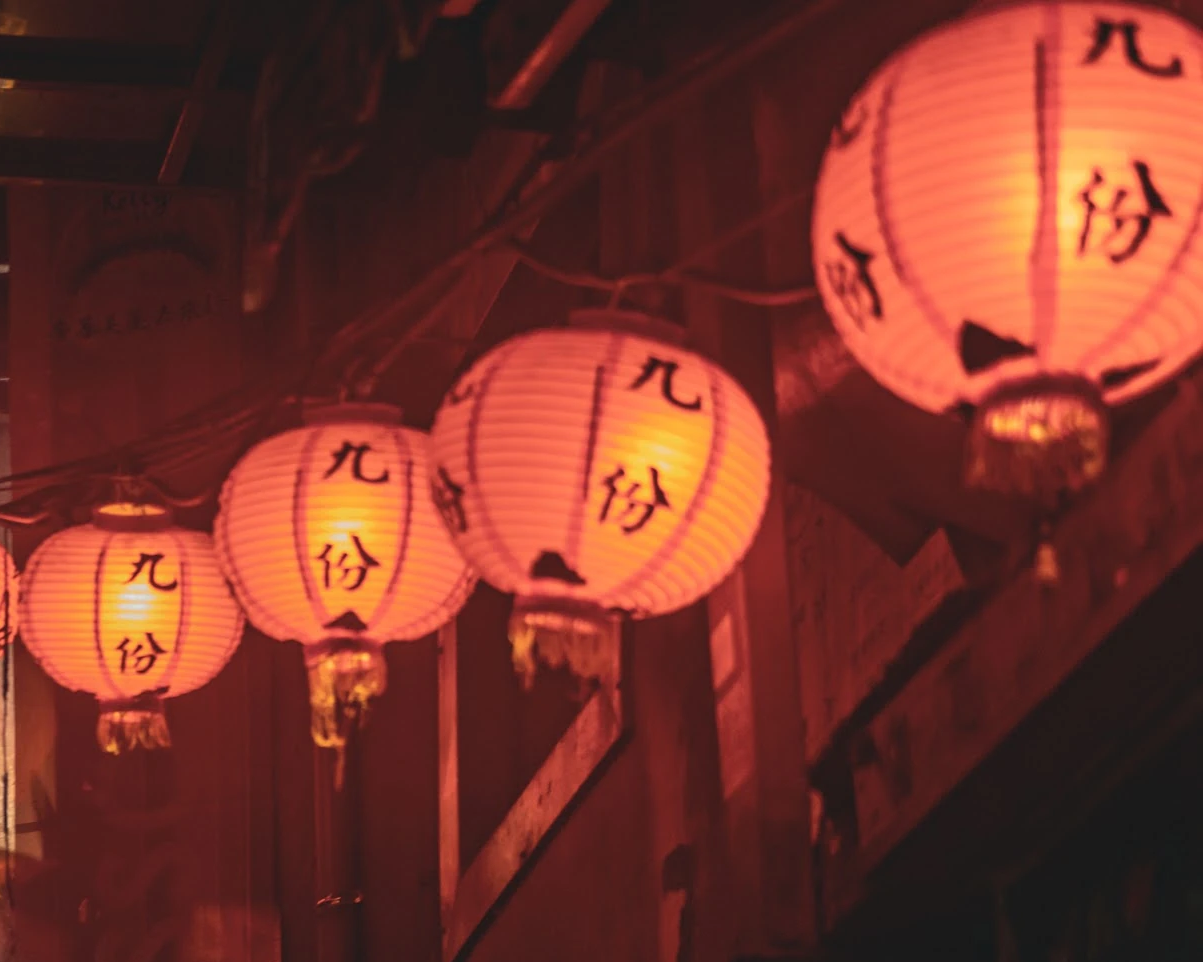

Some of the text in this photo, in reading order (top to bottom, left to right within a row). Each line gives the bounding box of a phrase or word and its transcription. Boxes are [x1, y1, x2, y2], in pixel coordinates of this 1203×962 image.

[1078, 14, 1184, 264] 九份
[316, 440, 390, 592] 九份
[600, 355, 702, 535] 九份
[116, 552, 179, 675] 九份
